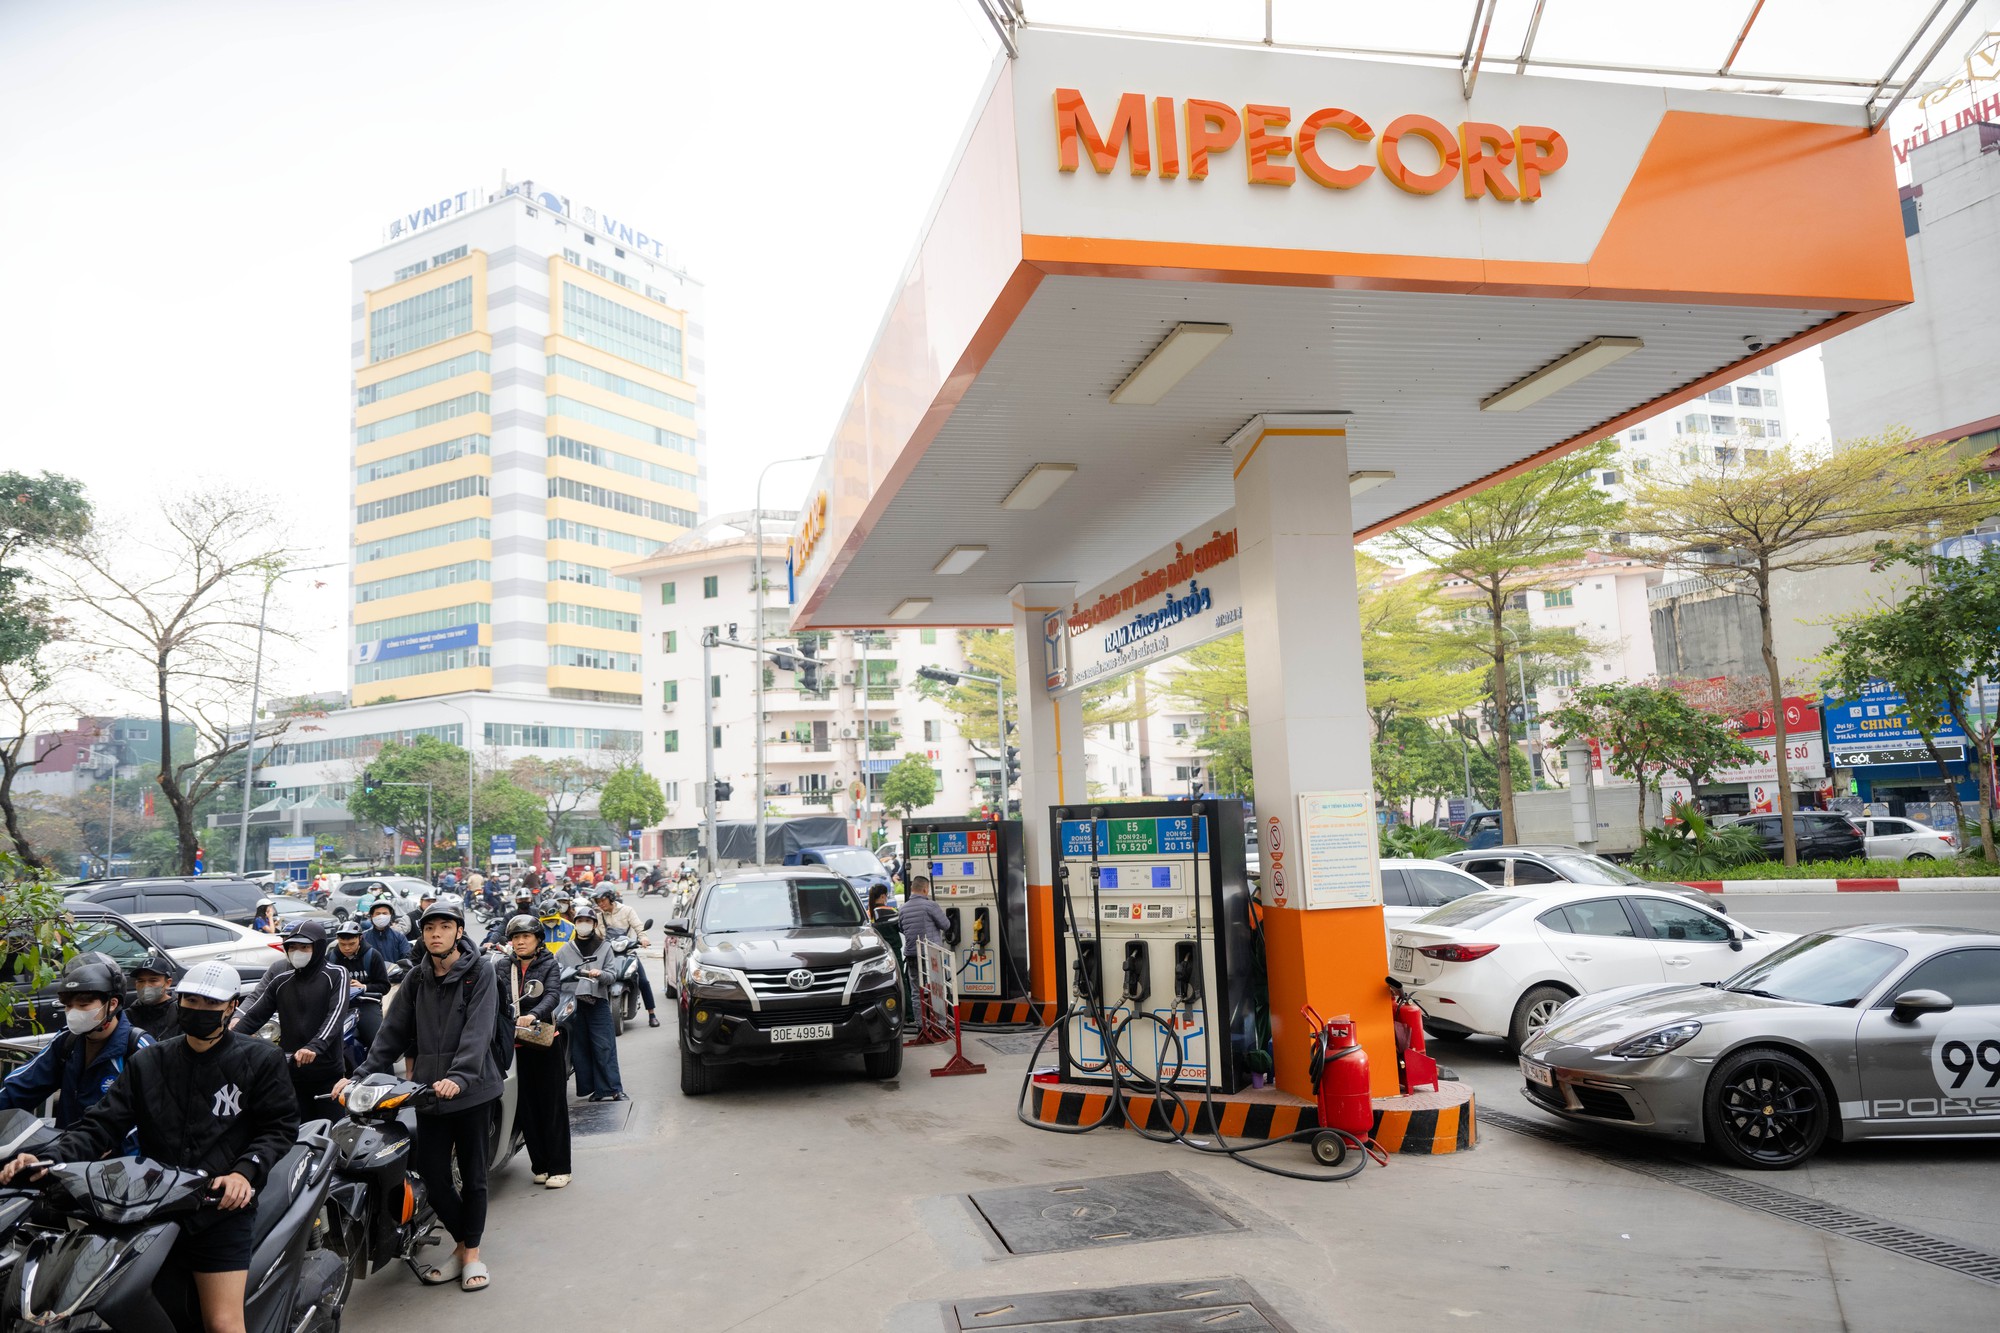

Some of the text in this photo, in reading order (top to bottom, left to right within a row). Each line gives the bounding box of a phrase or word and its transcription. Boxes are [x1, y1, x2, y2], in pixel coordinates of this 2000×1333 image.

[1052, 87, 1570, 203] MIPECORP
[407, 191, 467, 231] VNPT
[602, 214, 664, 257] VNPT
[1860, 717, 1902, 730] CHINH
[1794, 742, 1808, 759] SỐ
[1079, 823, 1091, 833] 95
[1127, 822, 1139, 832] E5
[1174, 819, 1188, 830] 95
[1116, 843, 1148, 852] 19.520
[772, 1026, 831, 1041] 30E-499.54
[1941, 1039, 2000, 1089] 99
